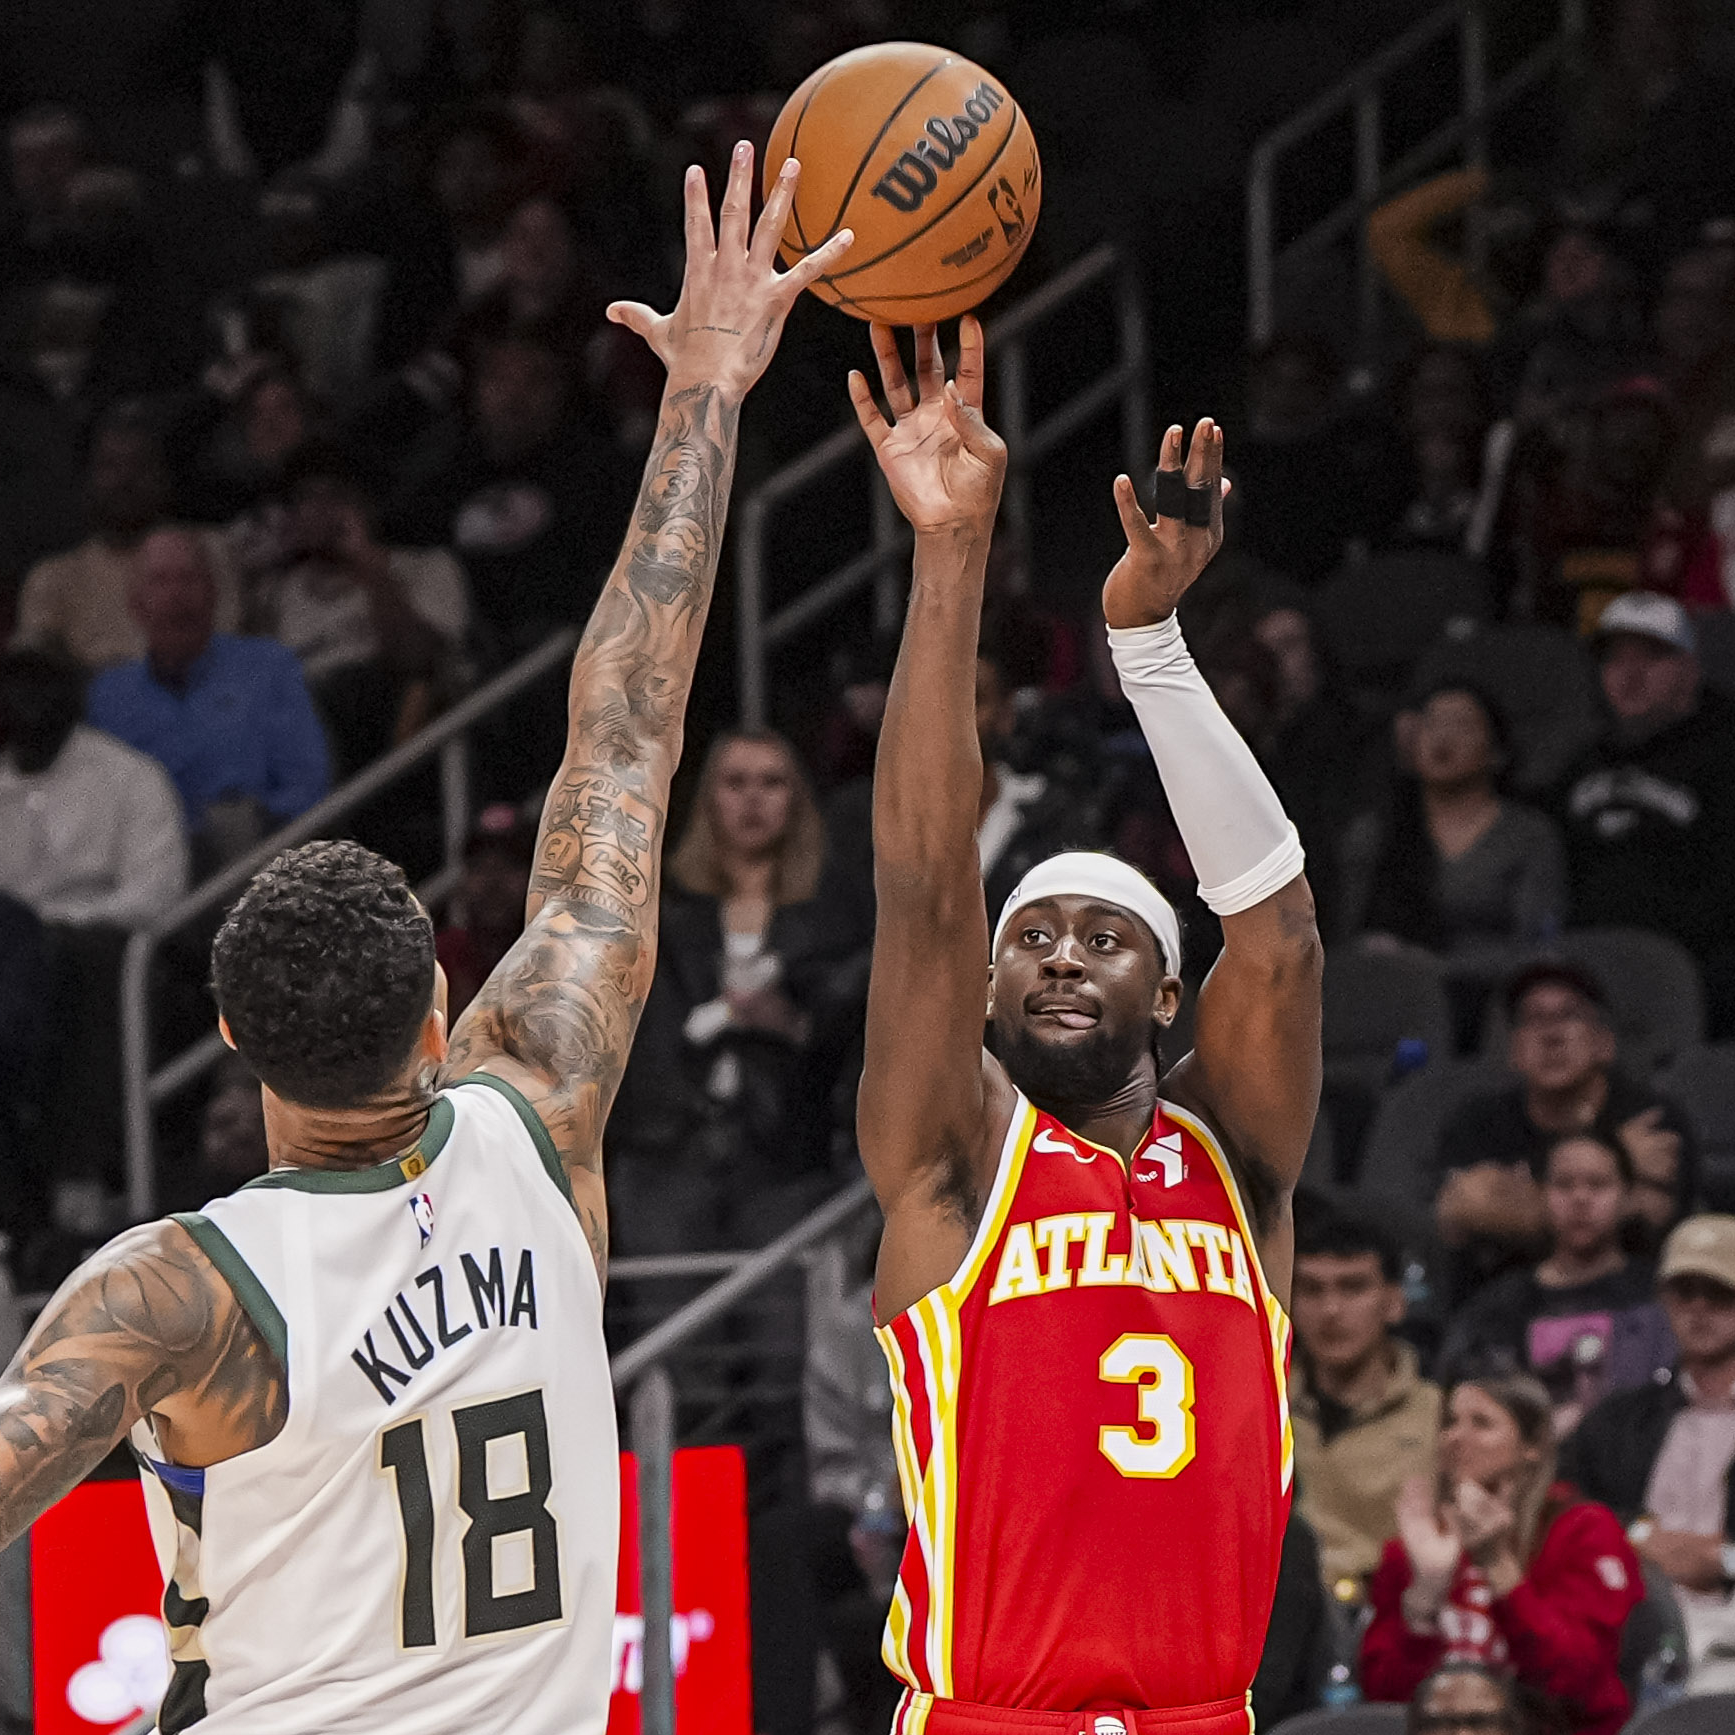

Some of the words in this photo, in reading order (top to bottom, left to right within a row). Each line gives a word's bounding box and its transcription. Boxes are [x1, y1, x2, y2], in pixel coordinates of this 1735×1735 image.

[870, 80, 1005, 214] Wilson
[1135, 1170, 1159, 1183] the
[351, 1248, 539, 1405] KUZMA
[987, 1211, 1258, 1314] ATLANTA
[1097, 1332, 1197, 1479] 3
[376, 1382, 570, 1656] 18
